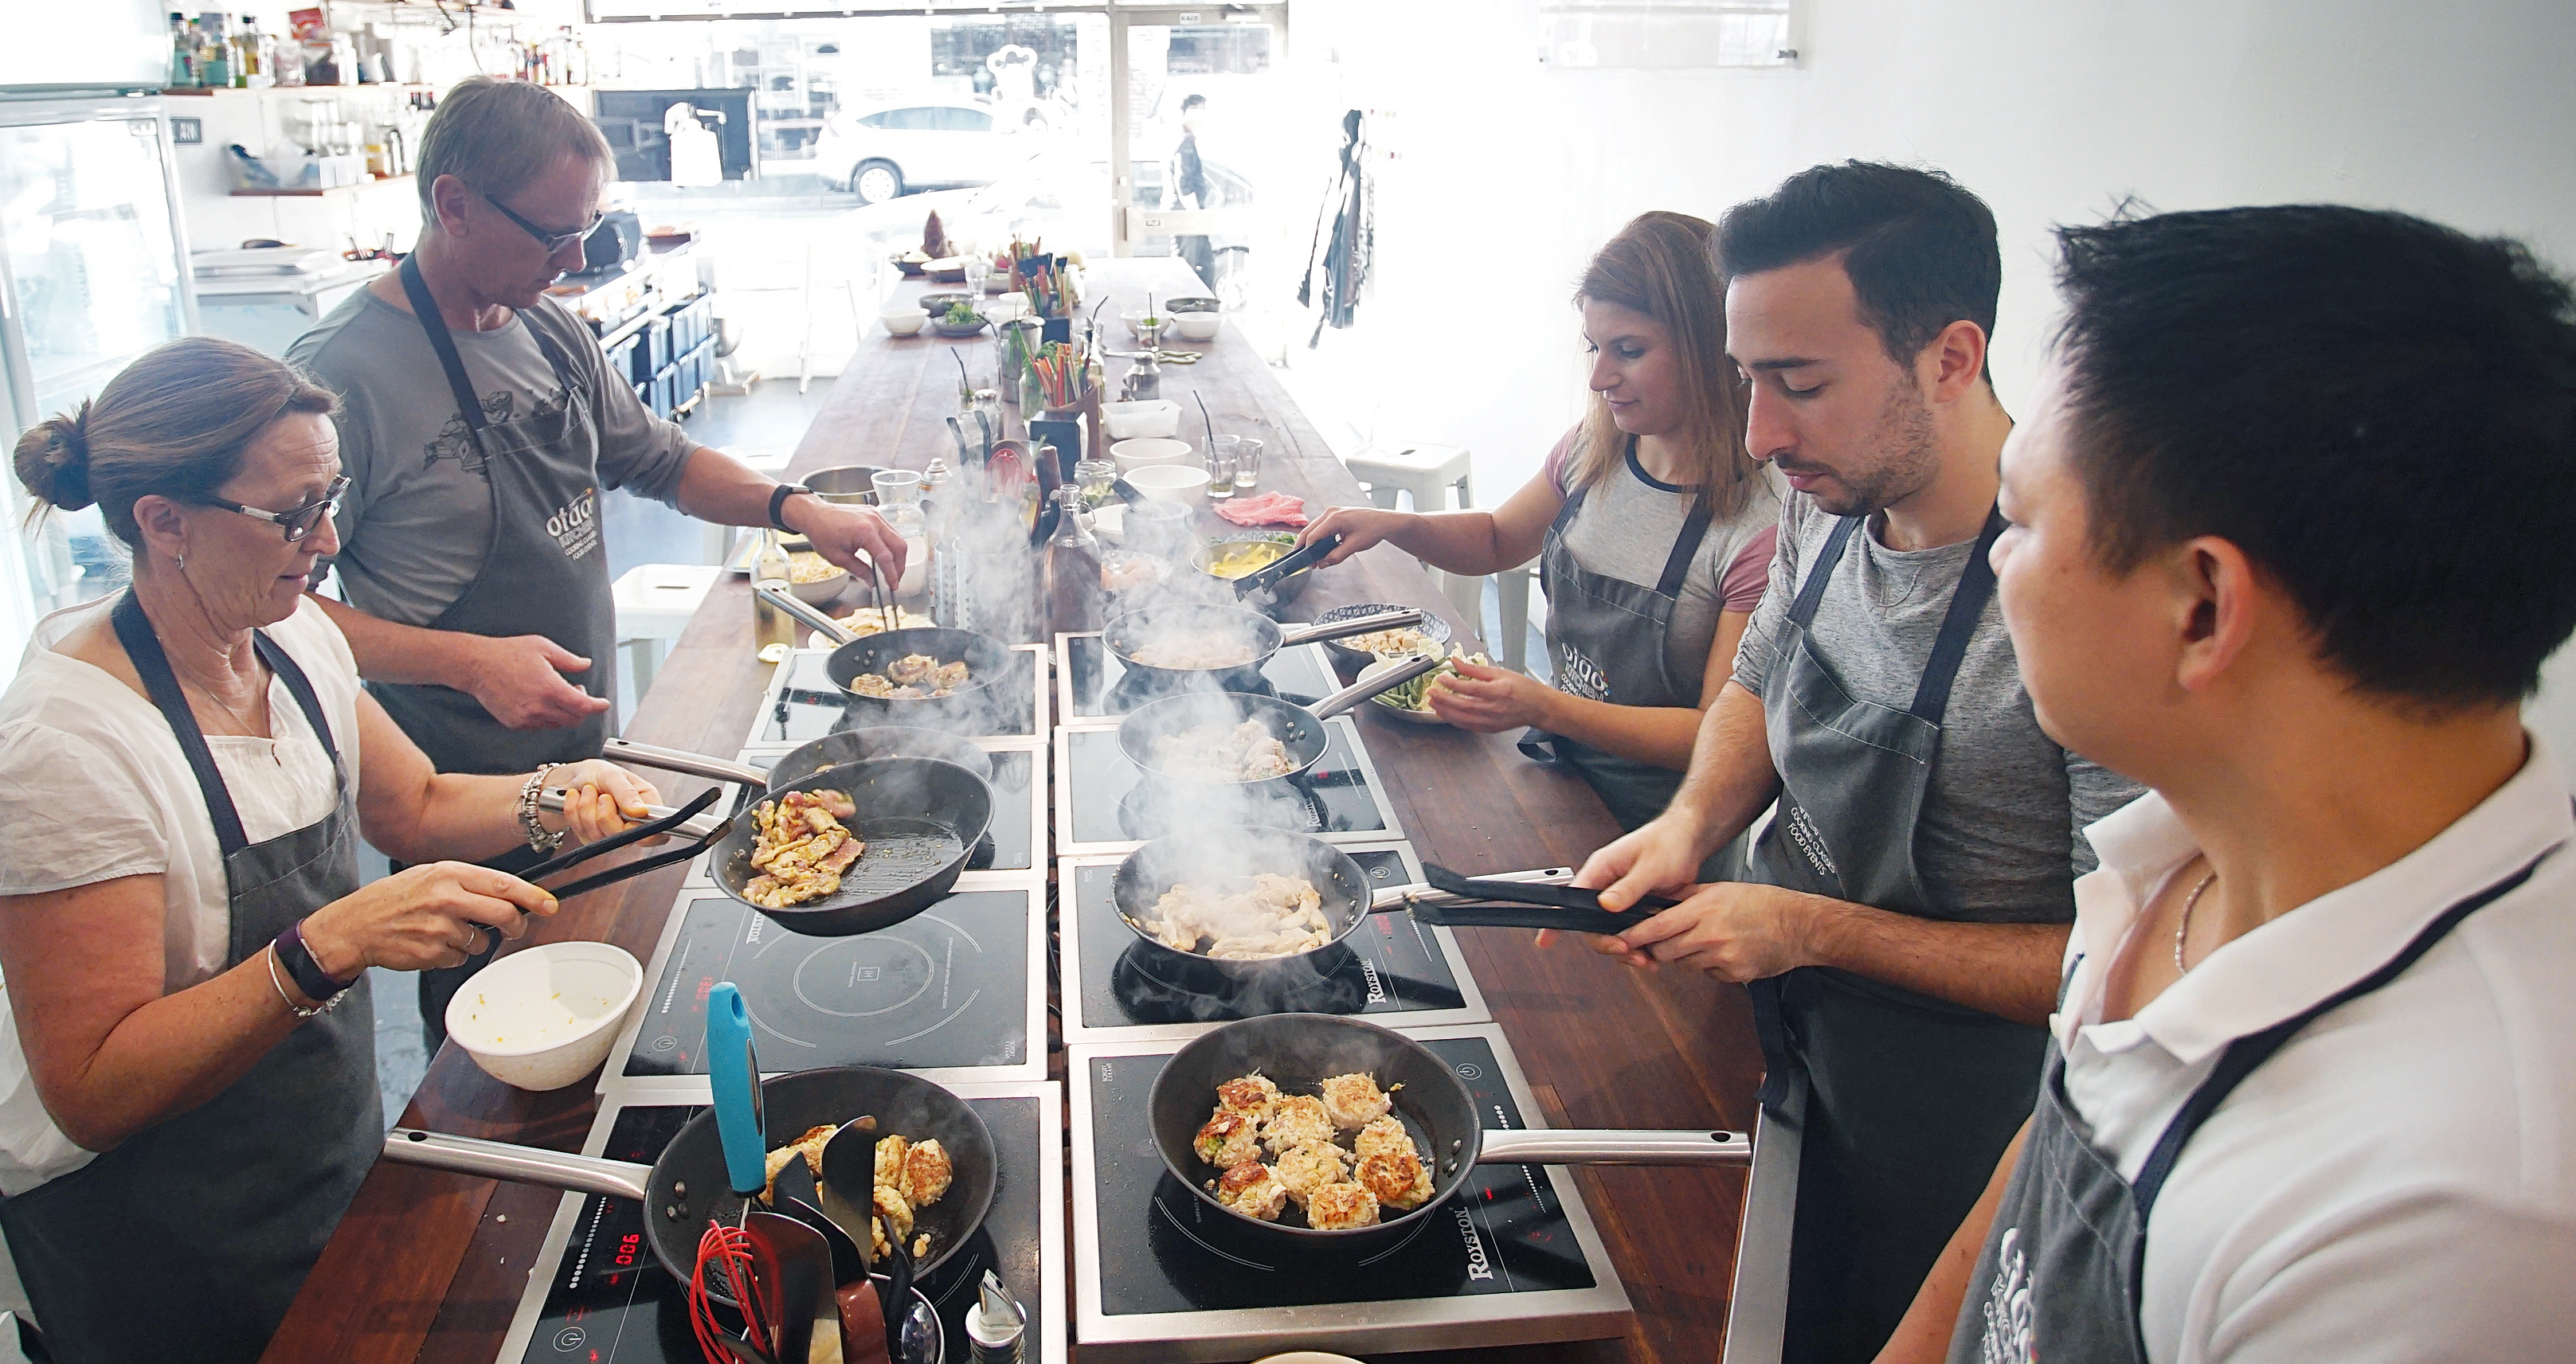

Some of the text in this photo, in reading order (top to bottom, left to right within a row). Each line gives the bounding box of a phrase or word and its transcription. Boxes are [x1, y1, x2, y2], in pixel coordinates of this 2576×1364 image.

[1787, 823, 1806, 846] FOOD
[1803, 845, 1826, 876] EVENTS
[1791, 807, 1814, 842] COOKING
[1812, 841, 1835, 874] CLASSES
[746, 910, 765, 944] OYSTON
[616, 1233, 640, 1265] 900
